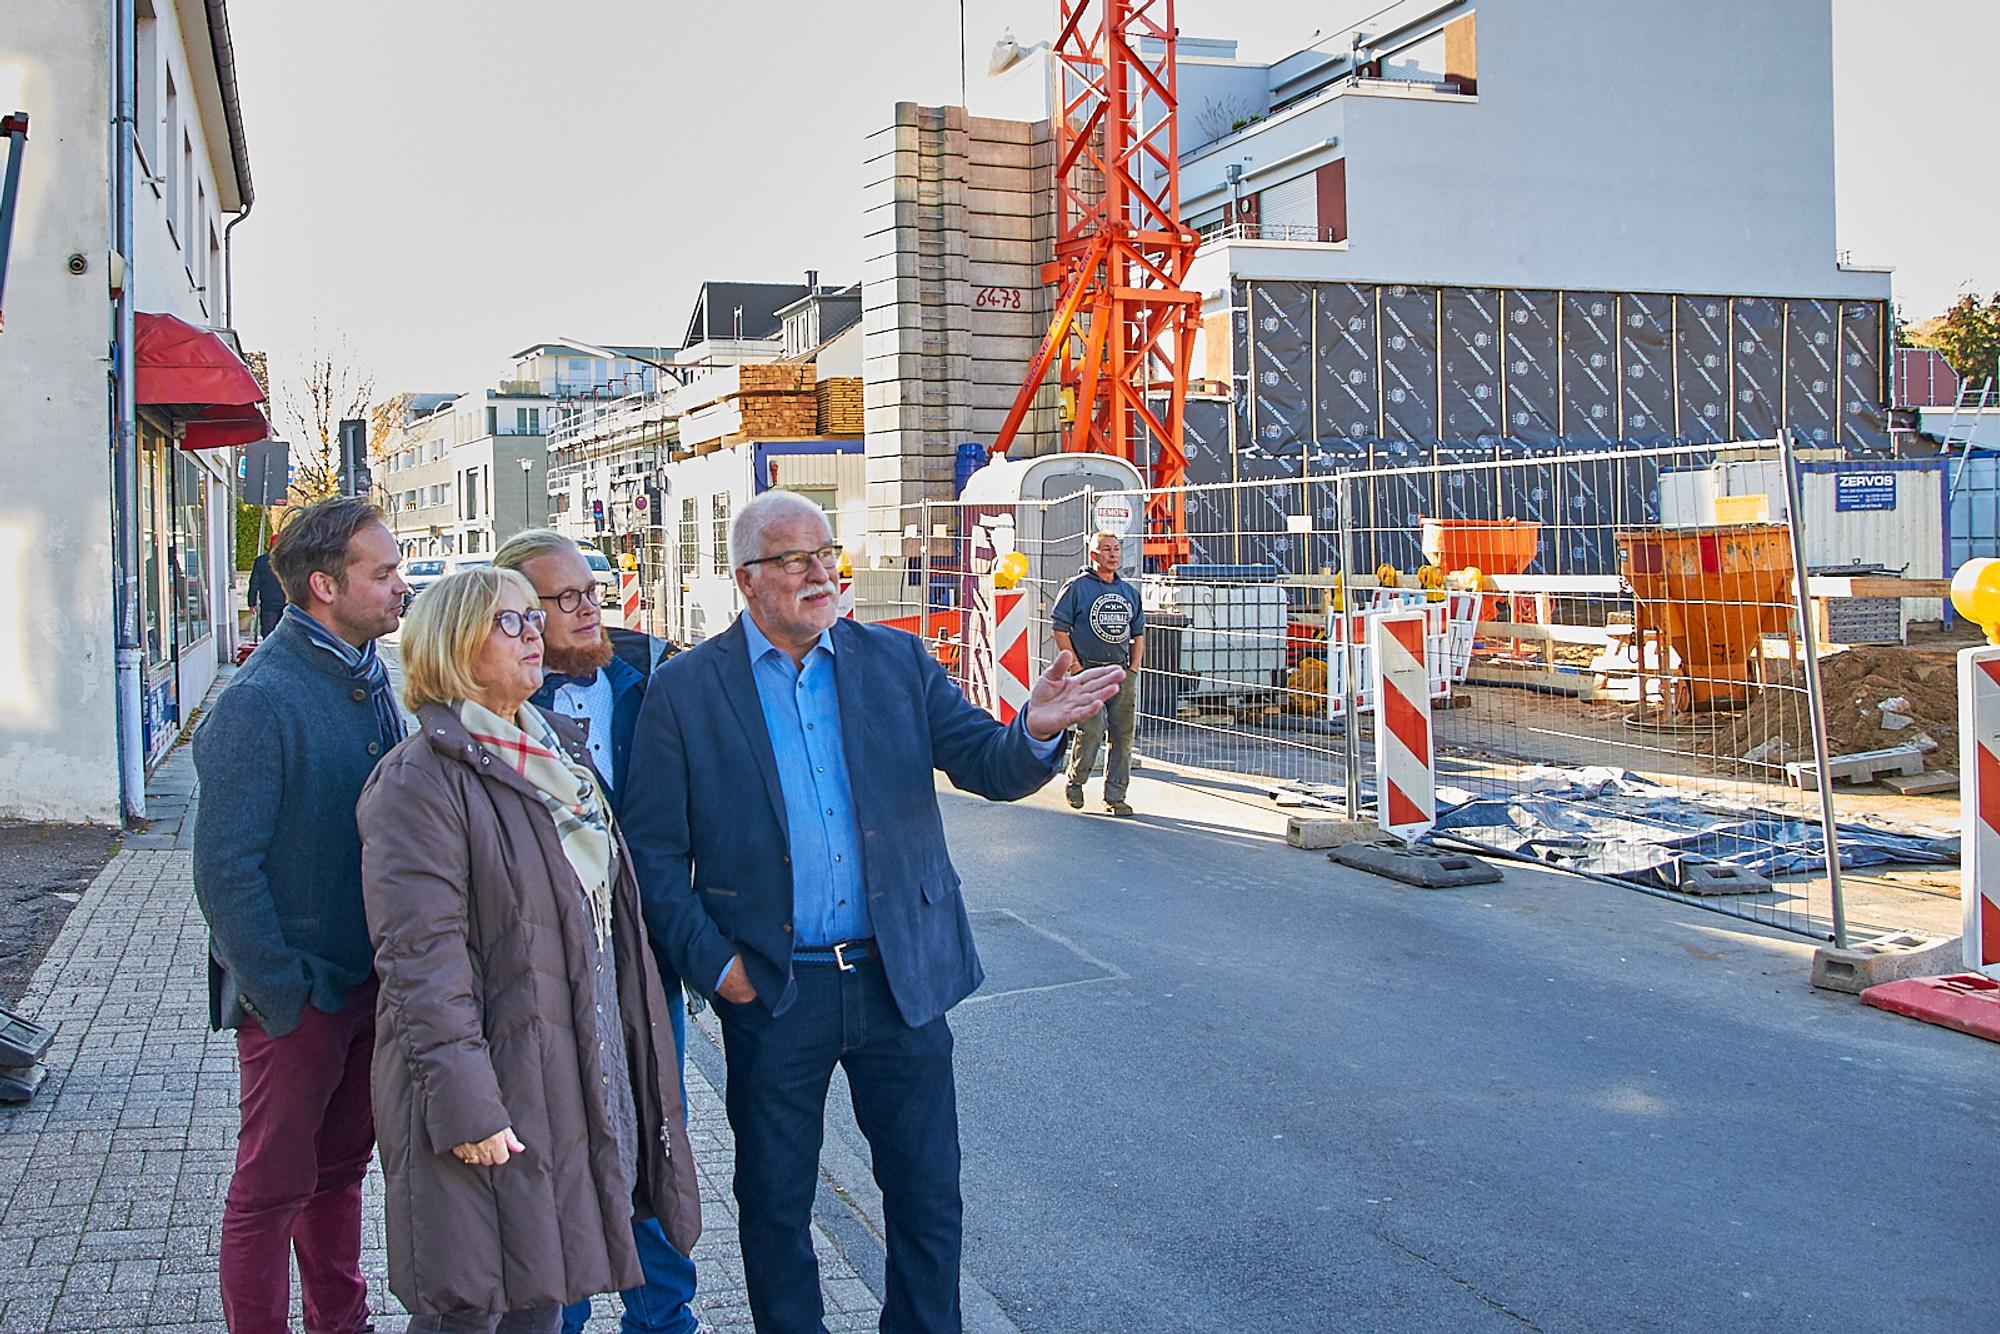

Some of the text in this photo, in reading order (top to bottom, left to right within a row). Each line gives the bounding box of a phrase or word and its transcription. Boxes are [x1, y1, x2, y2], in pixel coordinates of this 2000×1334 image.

[976, 287, 1021, 309] 6478
[1023, 332, 1052, 392] ARCOMET
[1839, 475, 1894, 487] ZERVOS
